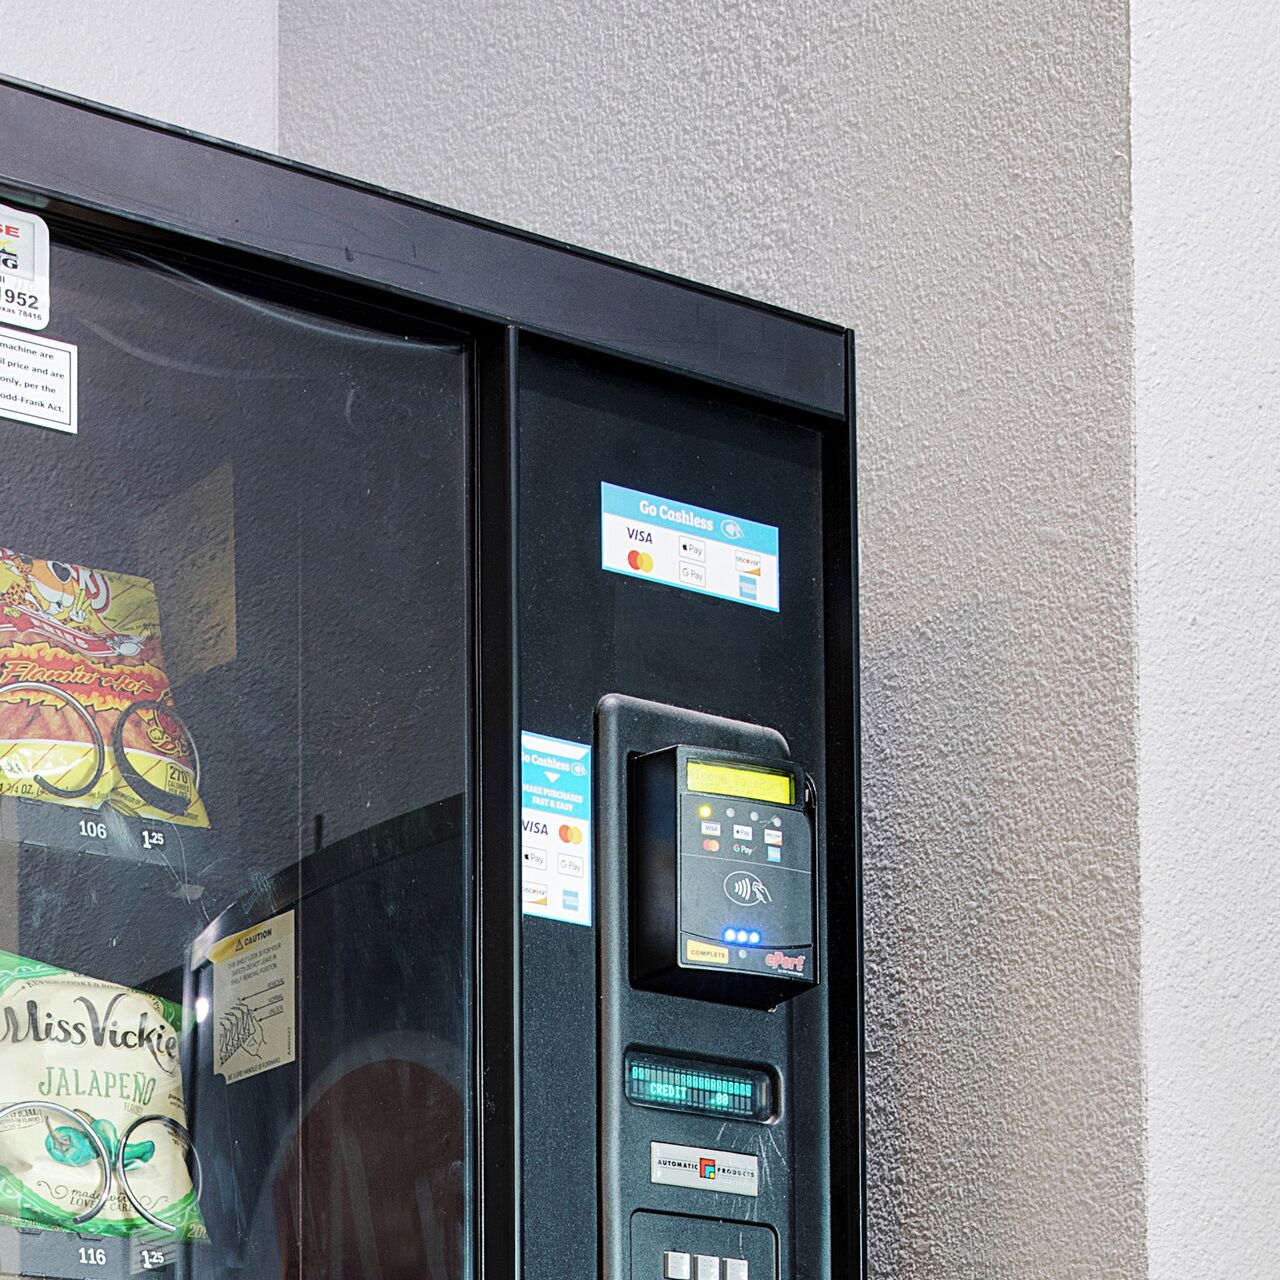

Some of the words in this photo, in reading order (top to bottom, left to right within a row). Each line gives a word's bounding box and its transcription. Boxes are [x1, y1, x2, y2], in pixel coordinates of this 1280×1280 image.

[18, 309, 42, 321] 78416
[0, 341, 37, 356] machine
[39, 352, 54, 360] are
[8, 358, 29, 373] price
[32, 363, 48, 376] and
[51, 371, 64, 379] are
[0, 373, 22, 387] only,
[24, 380, 39, 391] per
[41, 383, 56, 394] the
[48, 402, 64, 413] Act.
[640, 500, 657, 516] Go
[659, 506, 713, 531] Cashless
[626, 527, 653, 544] VISA
[689, 544, 702, 557] Pay
[691, 570, 703, 582] Pay
[531, 755, 570, 772] Cashless
[79, 821, 107, 838] 106
[522, 820, 548, 836] VISA
[244, 928, 272, 946] CAUTION
[690, 950, 726, 958] COMPLETE
[765, 953, 804, 971] ePort
[38, 1066, 156, 1106] JALAPEÑO
[650, 1082, 686, 1099] CREDIT
[658, 1160, 698, 1170] AUTOMATIC
[718, 1168, 754, 1178] PRODUCTS
[79, 1248, 106, 1264] 116
